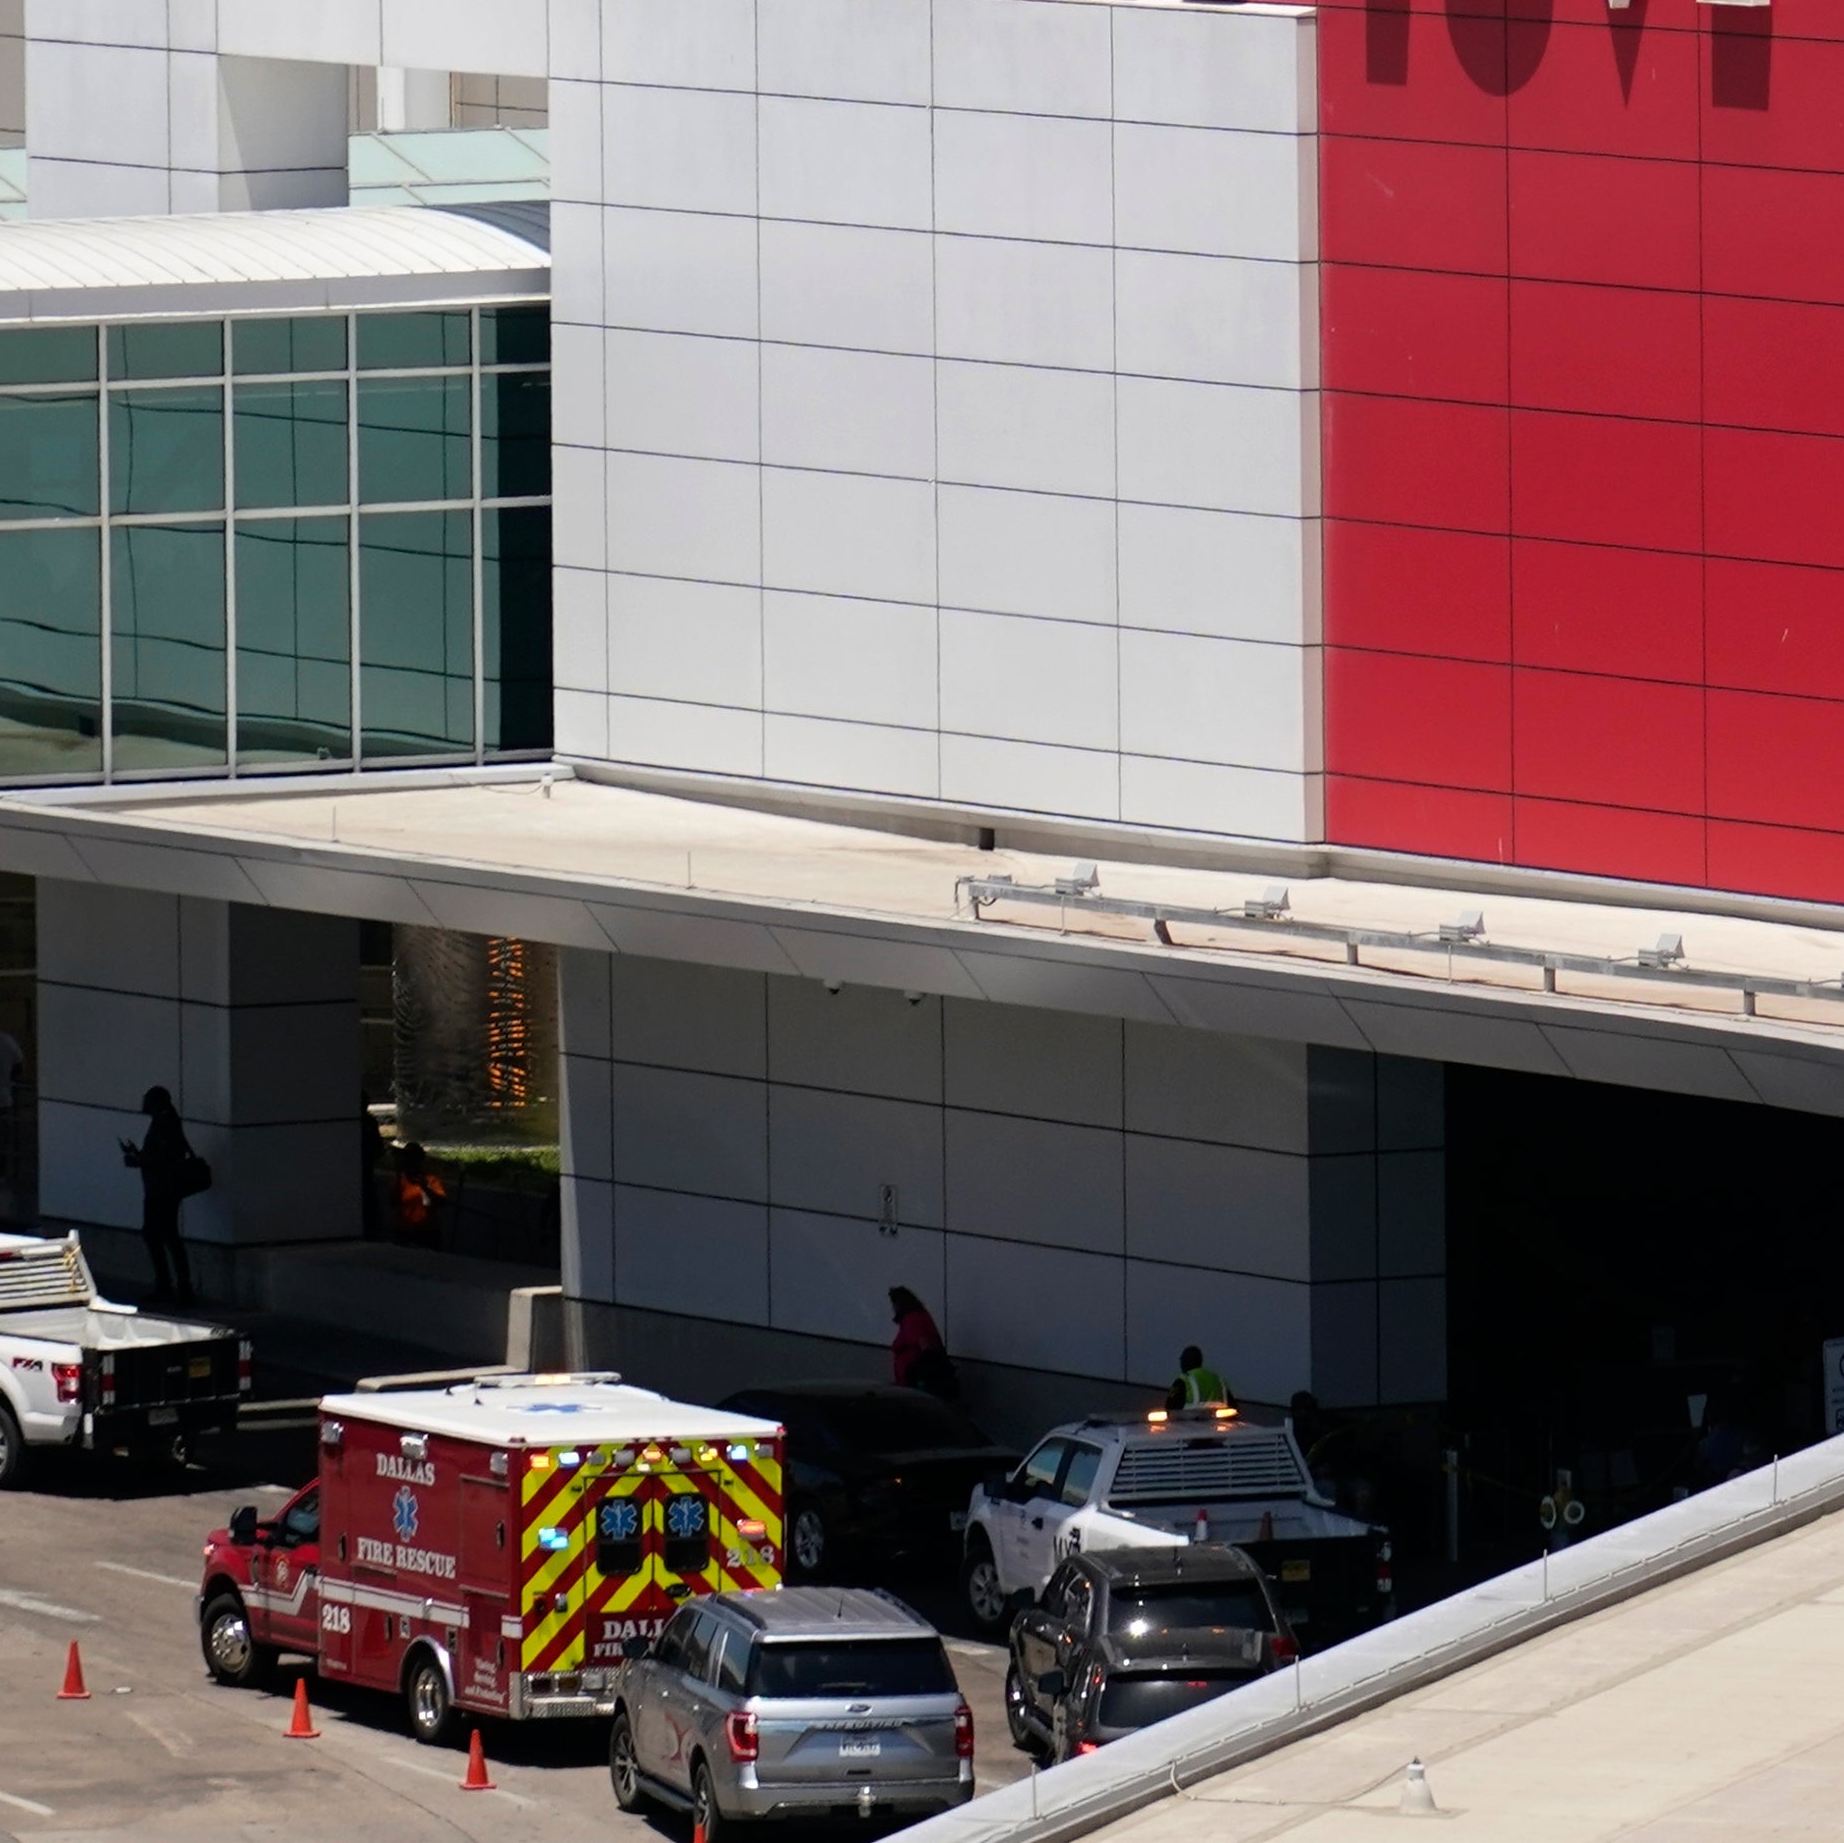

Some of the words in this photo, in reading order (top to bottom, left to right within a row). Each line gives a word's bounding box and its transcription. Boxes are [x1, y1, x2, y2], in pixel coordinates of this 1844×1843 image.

[12, 1357, 44, 1372] FX4
[375, 1452, 436, 1487] DALLAS
[357, 1536, 395, 1566] FIRE
[396, 1545, 457, 1580] RESCUE
[726, 1544, 775, 1569] 218
[322, 1603, 351, 1635] 218
